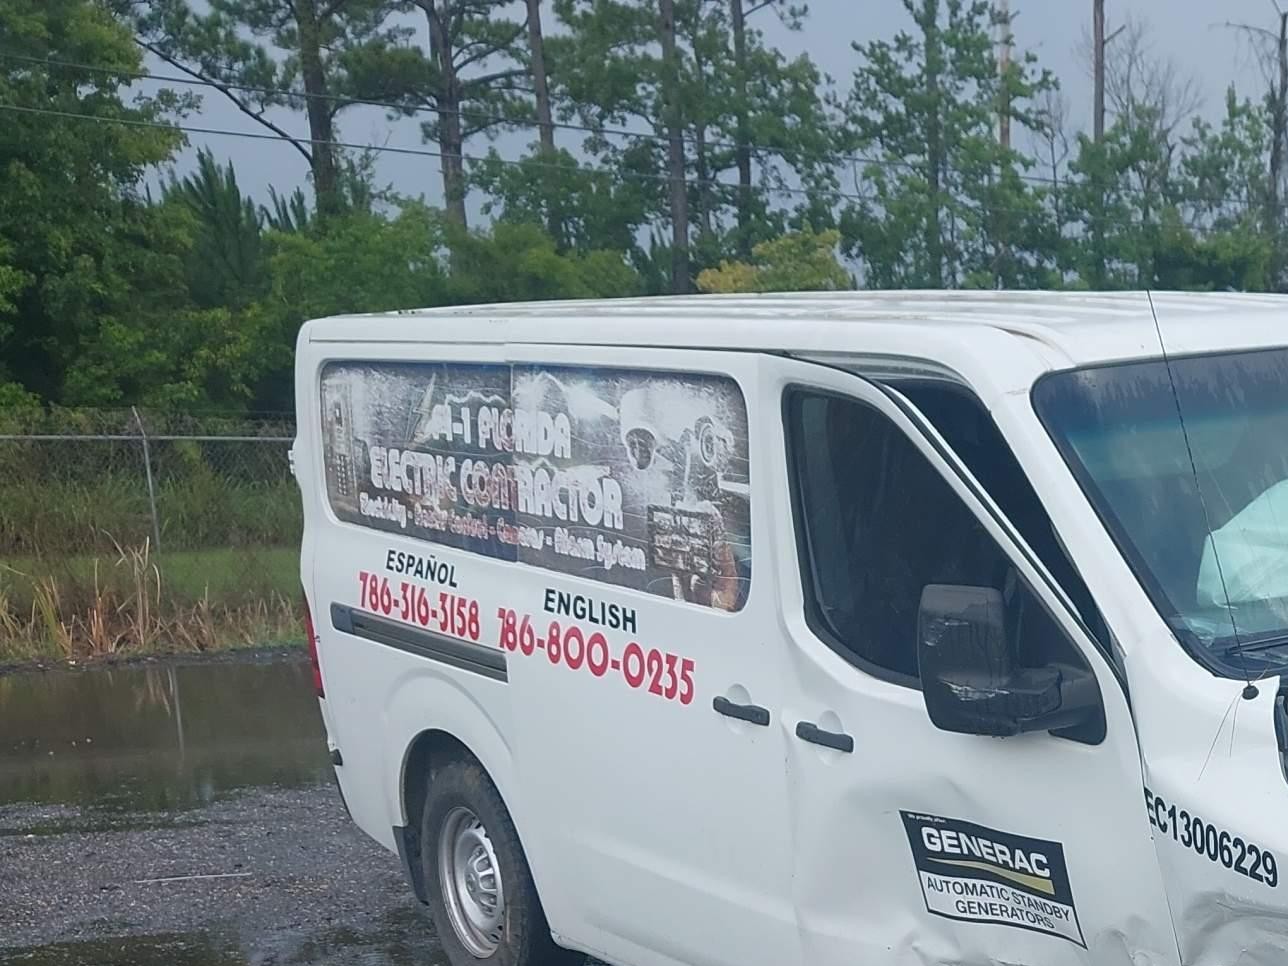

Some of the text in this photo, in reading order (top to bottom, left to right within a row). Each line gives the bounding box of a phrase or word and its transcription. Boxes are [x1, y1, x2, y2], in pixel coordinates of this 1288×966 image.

[369, 446, 457, 502] ELECTRIC
[460, 458, 623, 530] CONTRACTOR
[386, 550, 457, 588] ESPAÑOL
[359, 572, 480, 641] 786-316-3158
[543, 588, 637, 634] ENGLISH
[498, 607, 695, 706] 786-800-0235
[921, 827, 1050, 877] GENERAC
[1144, 787, 1278, 887] EC13006229
[927, 877, 1069, 921] AUTOMATIC STANDBY
[955, 900, 1054, 928] GENERATORS
